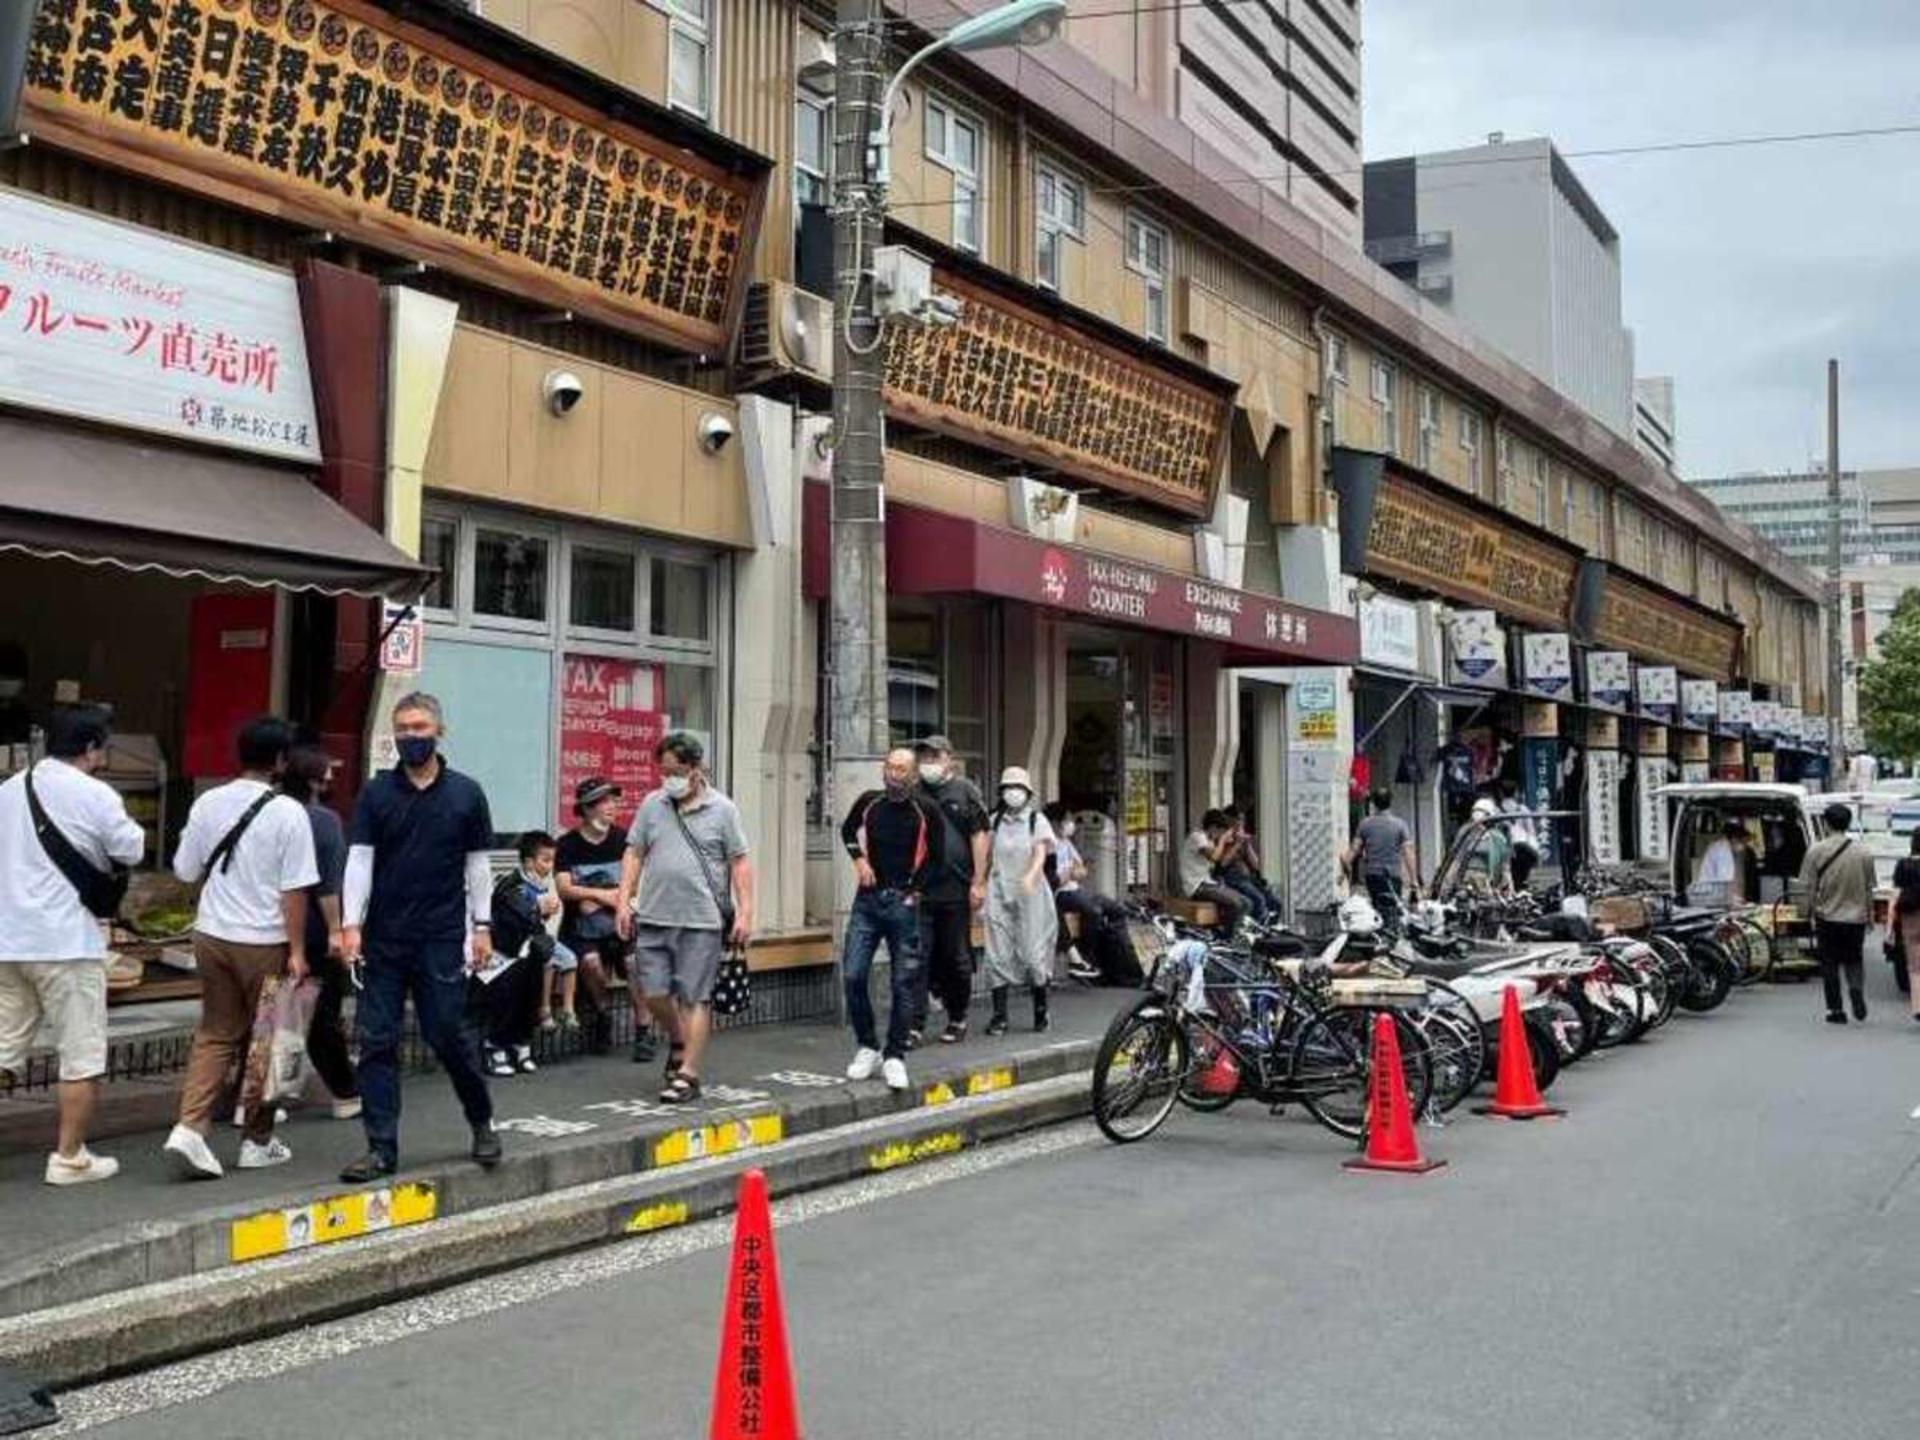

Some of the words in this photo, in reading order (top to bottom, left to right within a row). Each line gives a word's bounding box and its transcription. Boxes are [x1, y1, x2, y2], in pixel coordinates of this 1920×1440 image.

[1088, 586, 1147, 618] COUNTER
[1185, 582, 1243, 615] EXCHANGE
[562, 661, 607, 694] TAX
